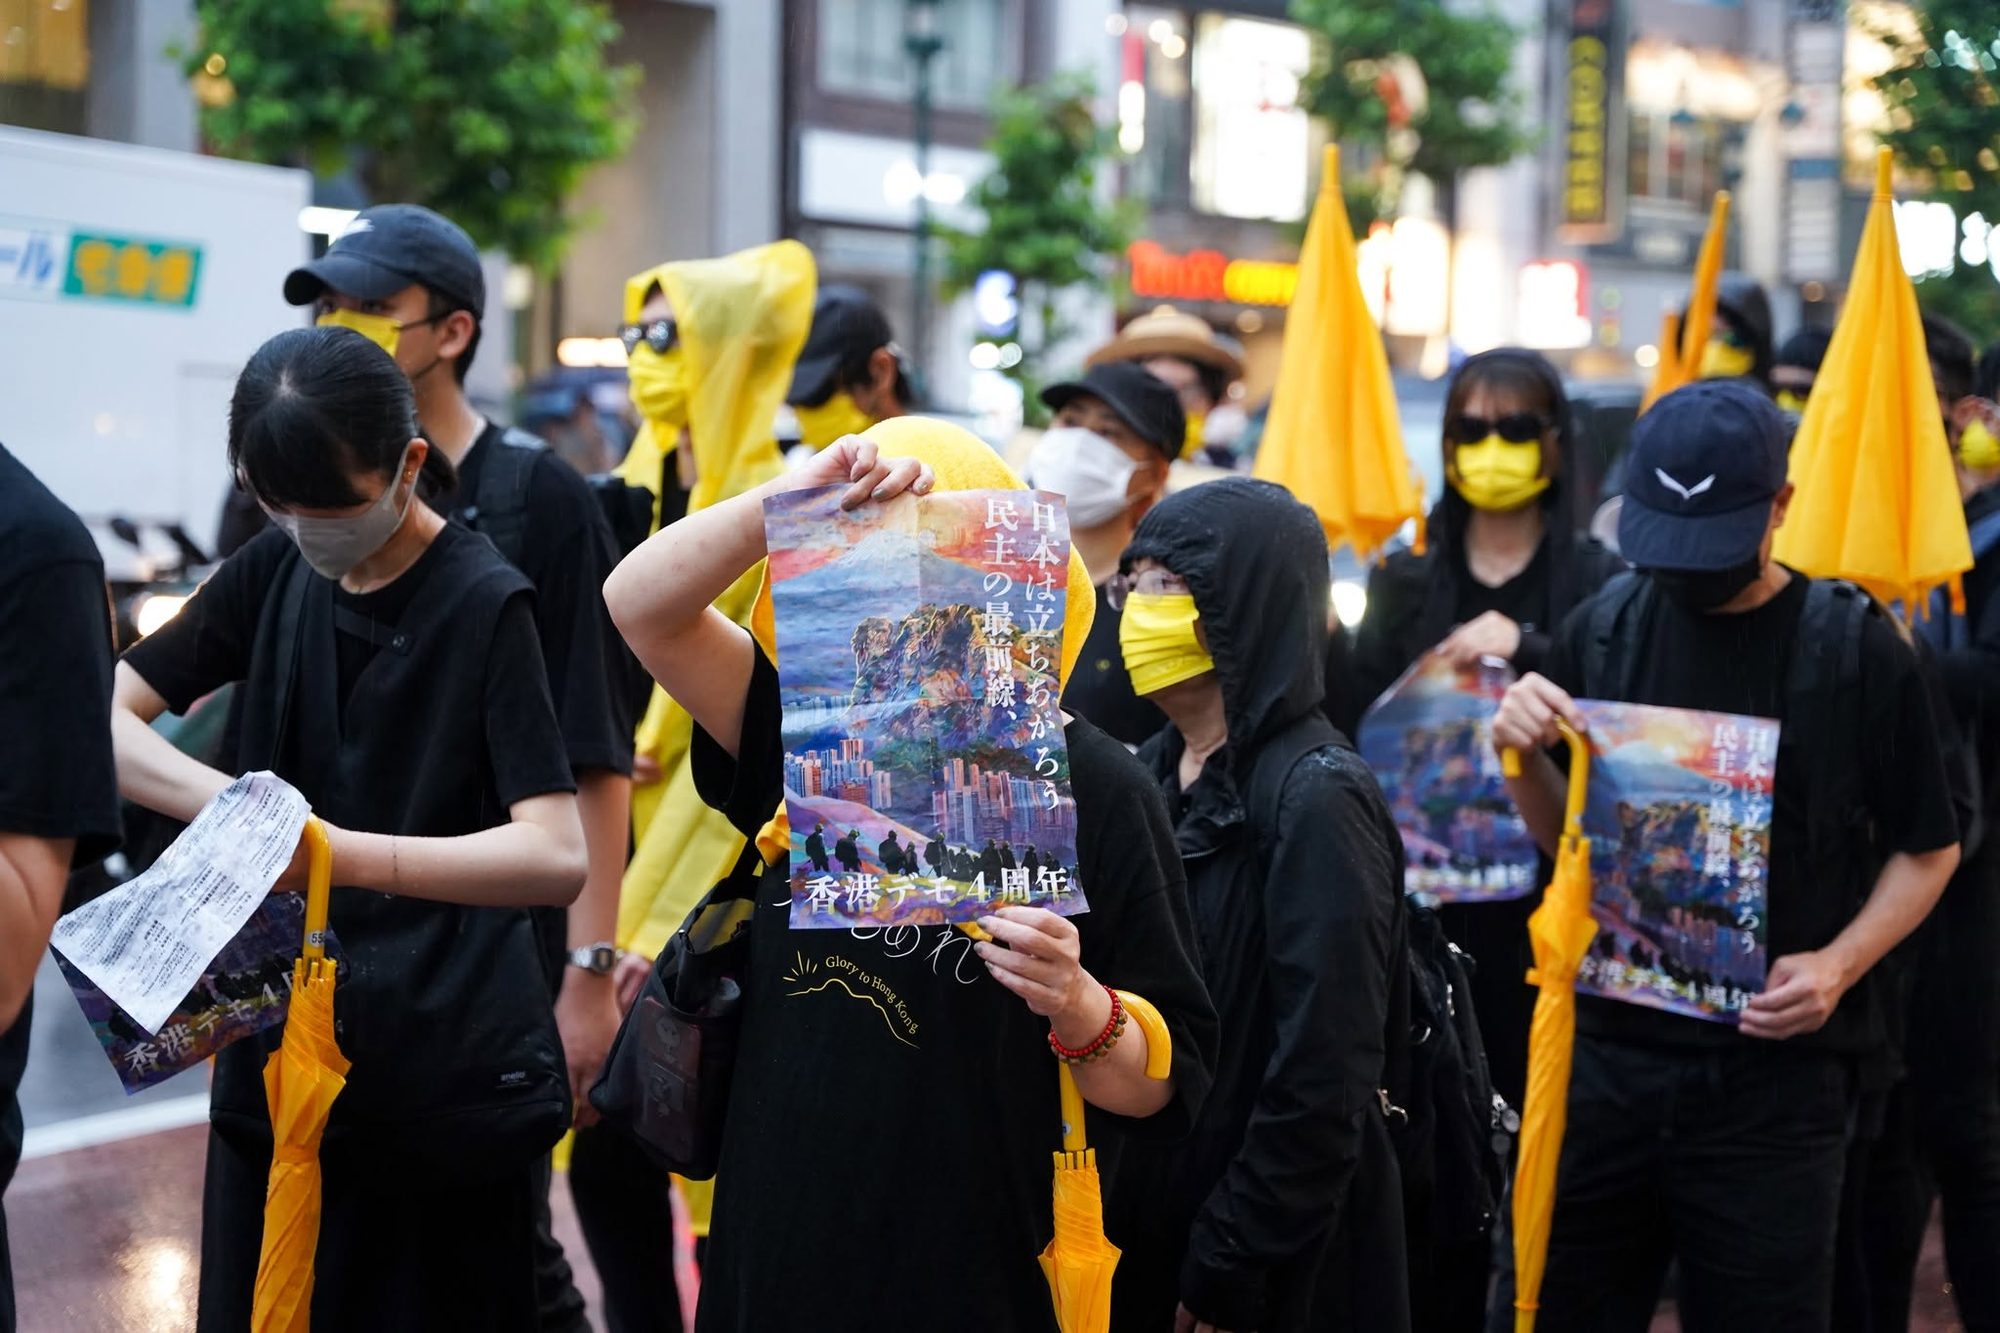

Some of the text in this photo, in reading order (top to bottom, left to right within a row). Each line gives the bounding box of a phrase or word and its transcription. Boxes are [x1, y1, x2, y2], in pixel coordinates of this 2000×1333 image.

[982, 498, 1018, 720] 民主の最前線、
[1022, 501, 1061, 811] 日本は立ちあがろう
[804, 866, 1072, 915] 香港デモ4周年
[124, 970, 294, 1078] 香港デモ4
[825, 955, 919, 1034] Glory to Hong Kong
